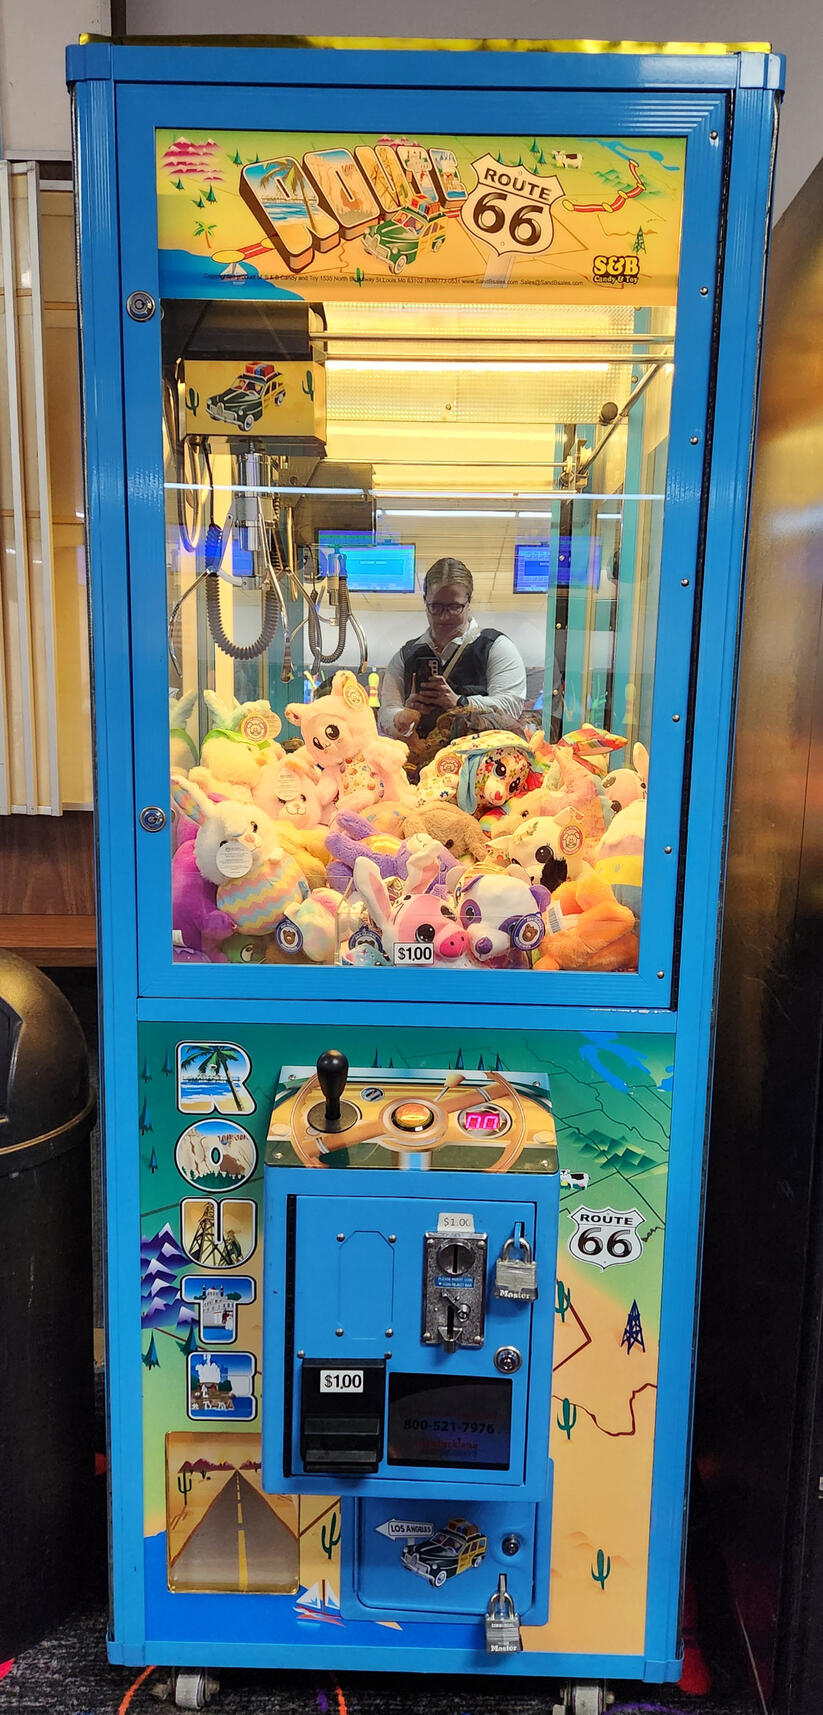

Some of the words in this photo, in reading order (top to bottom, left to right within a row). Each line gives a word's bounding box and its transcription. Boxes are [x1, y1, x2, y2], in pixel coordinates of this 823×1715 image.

[484, 167, 553, 202] ROUTE
[239, 144, 469, 274] ROUTE
[472, 191, 545, 247] 66
[593, 255, 640, 276] S&B
[593, 275, 615, 284] Candy
[617, 275, 624, 284] &
[625, 275, 638, 284] Toy
[398, 946, 432, 961] $1.00
[580, 1213, 634, 1226] ROUTE
[578, 1227, 633, 1258] 66
[499, 1289, 531, 1299] Master
[324, 1374, 362, 1389] $1.00
[403, 1420, 495, 1434] 800-521-7976
[390, 1524, 406, 1533] LOS
[406, 1524, 432, 1533] ANGELES
[490, 1644, 518, 1652] Master
